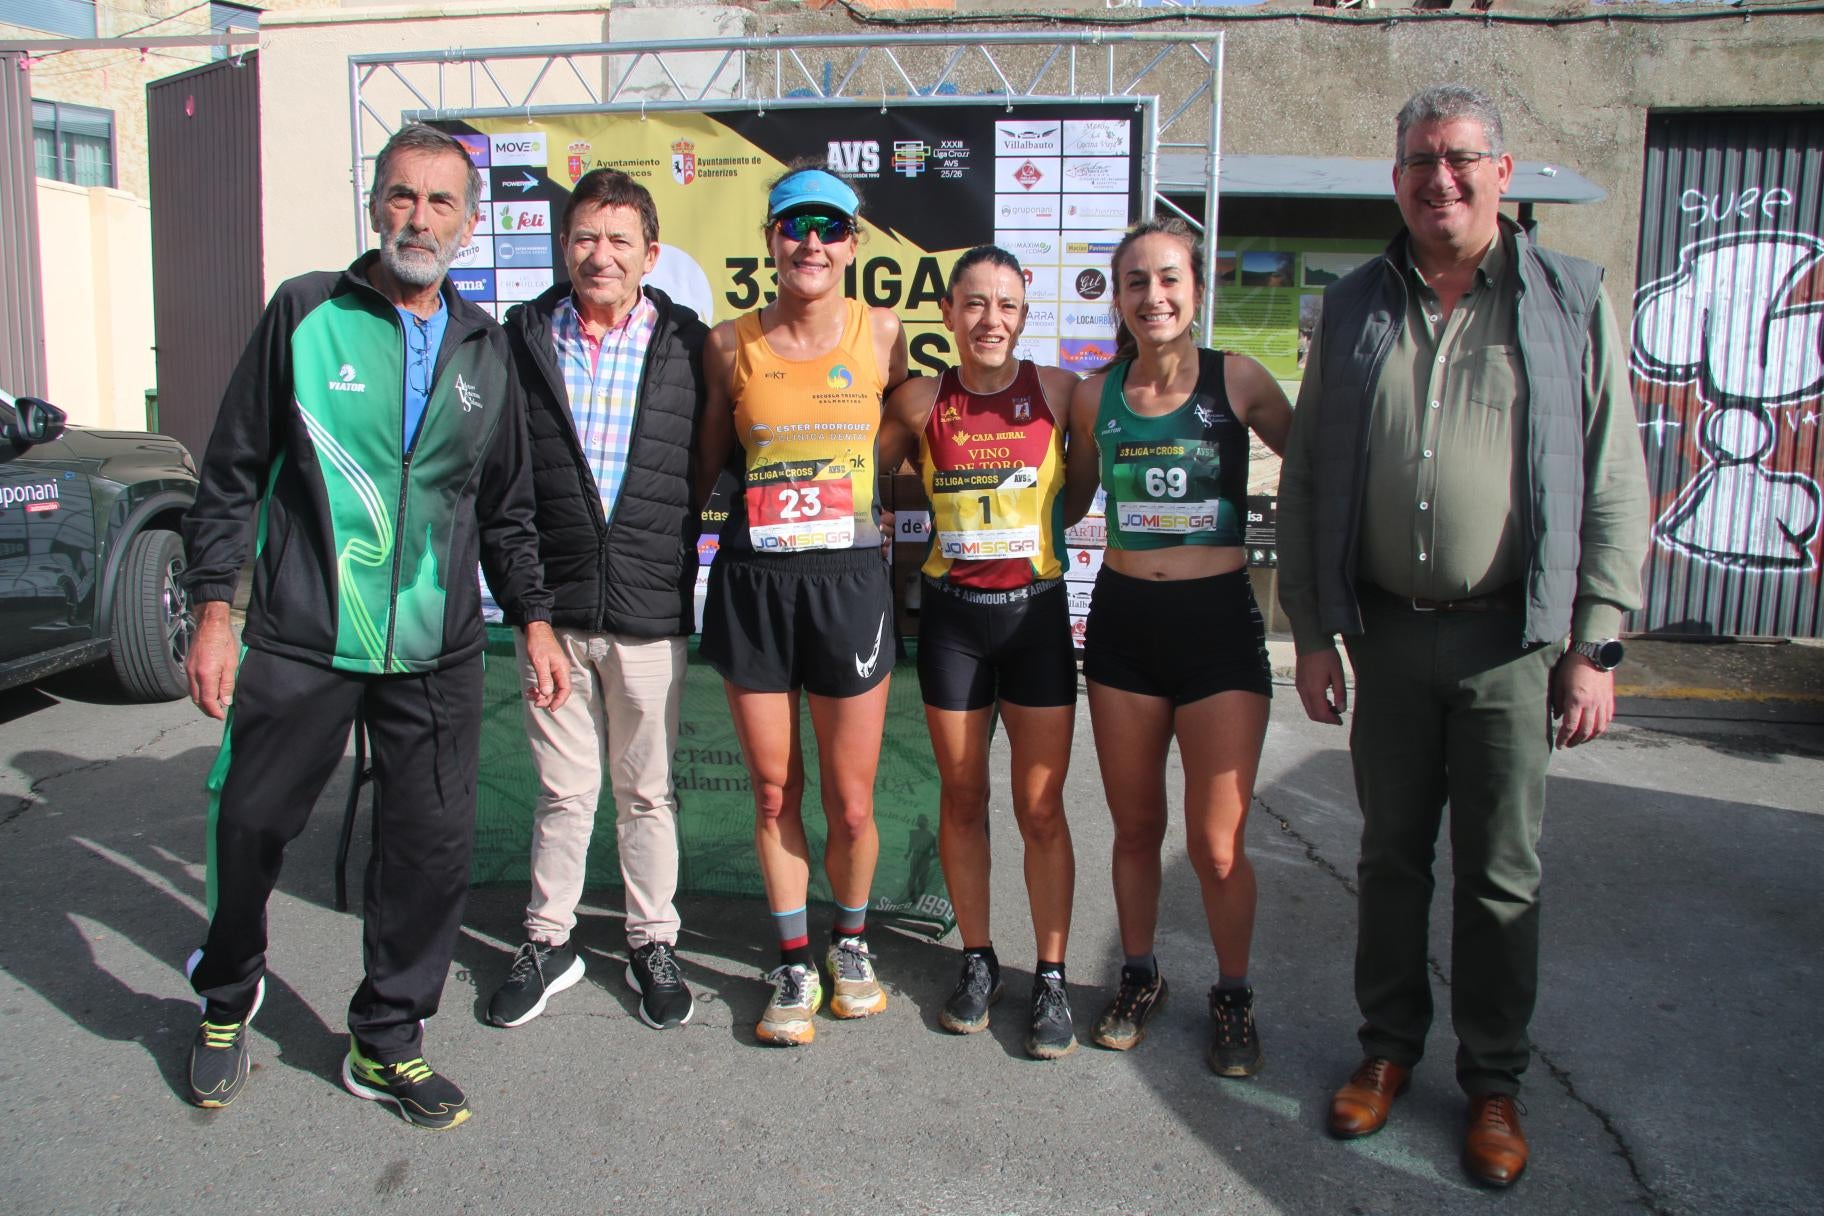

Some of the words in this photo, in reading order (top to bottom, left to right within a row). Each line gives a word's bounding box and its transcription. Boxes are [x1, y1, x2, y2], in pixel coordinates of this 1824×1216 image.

[1004, 141, 1054, 150] Villalbauto
[827, 140, 880, 173] AVS
[933, 150, 948, 159] Liga
[597, 159, 660, 169] Ayuntamiento
[697, 157, 750, 168] Ayuntamiento
[751, 156, 762, 165] de
[943, 160, 959, 168] AVS
[697, 169, 738, 178] Cabrerizos
[940, 170, 963, 178] 25/26
[1012, 207, 1053, 215] gruponani
[517, 212, 545, 231] feli
[453, 280, 485, 291] oma
[844, 256, 946, 310] IGA
[1026, 311, 1055, 320] ARRA
[328, 381, 366, 392] VIATOR
[776, 423, 811, 433] ESTER
[814, 422, 872, 431] RODRIGUEZ
[972, 433, 995, 442] CAJA
[996, 431, 1026, 440] RURAL
[968, 447, 1010, 460] VINO
[1120, 448, 1130, 457] 33
[1130, 447, 1149, 456] LIGA
[1156, 446, 1185, 456] CROSS
[748, 473, 758, 482] 33
[759, 470, 779, 480] LIGA
[785, 467, 813, 477] CROSS
[935, 479, 944, 487] 33
[945, 476, 964, 486] LIGA
[971, 475, 999, 485] CROSS
[1145, 467, 1187, 498] 69
[779, 486, 821, 518] 23
[978, 496, 991, 524] 1
[1121, 513, 1215, 528] JOMISAGA
[756, 532, 851, 549] JOMISAGA
[945, 540, 1035, 554] JOMISAGA
[962, 592, 1007, 605] ARMOUR
[875, 896, 913, 912] Since
